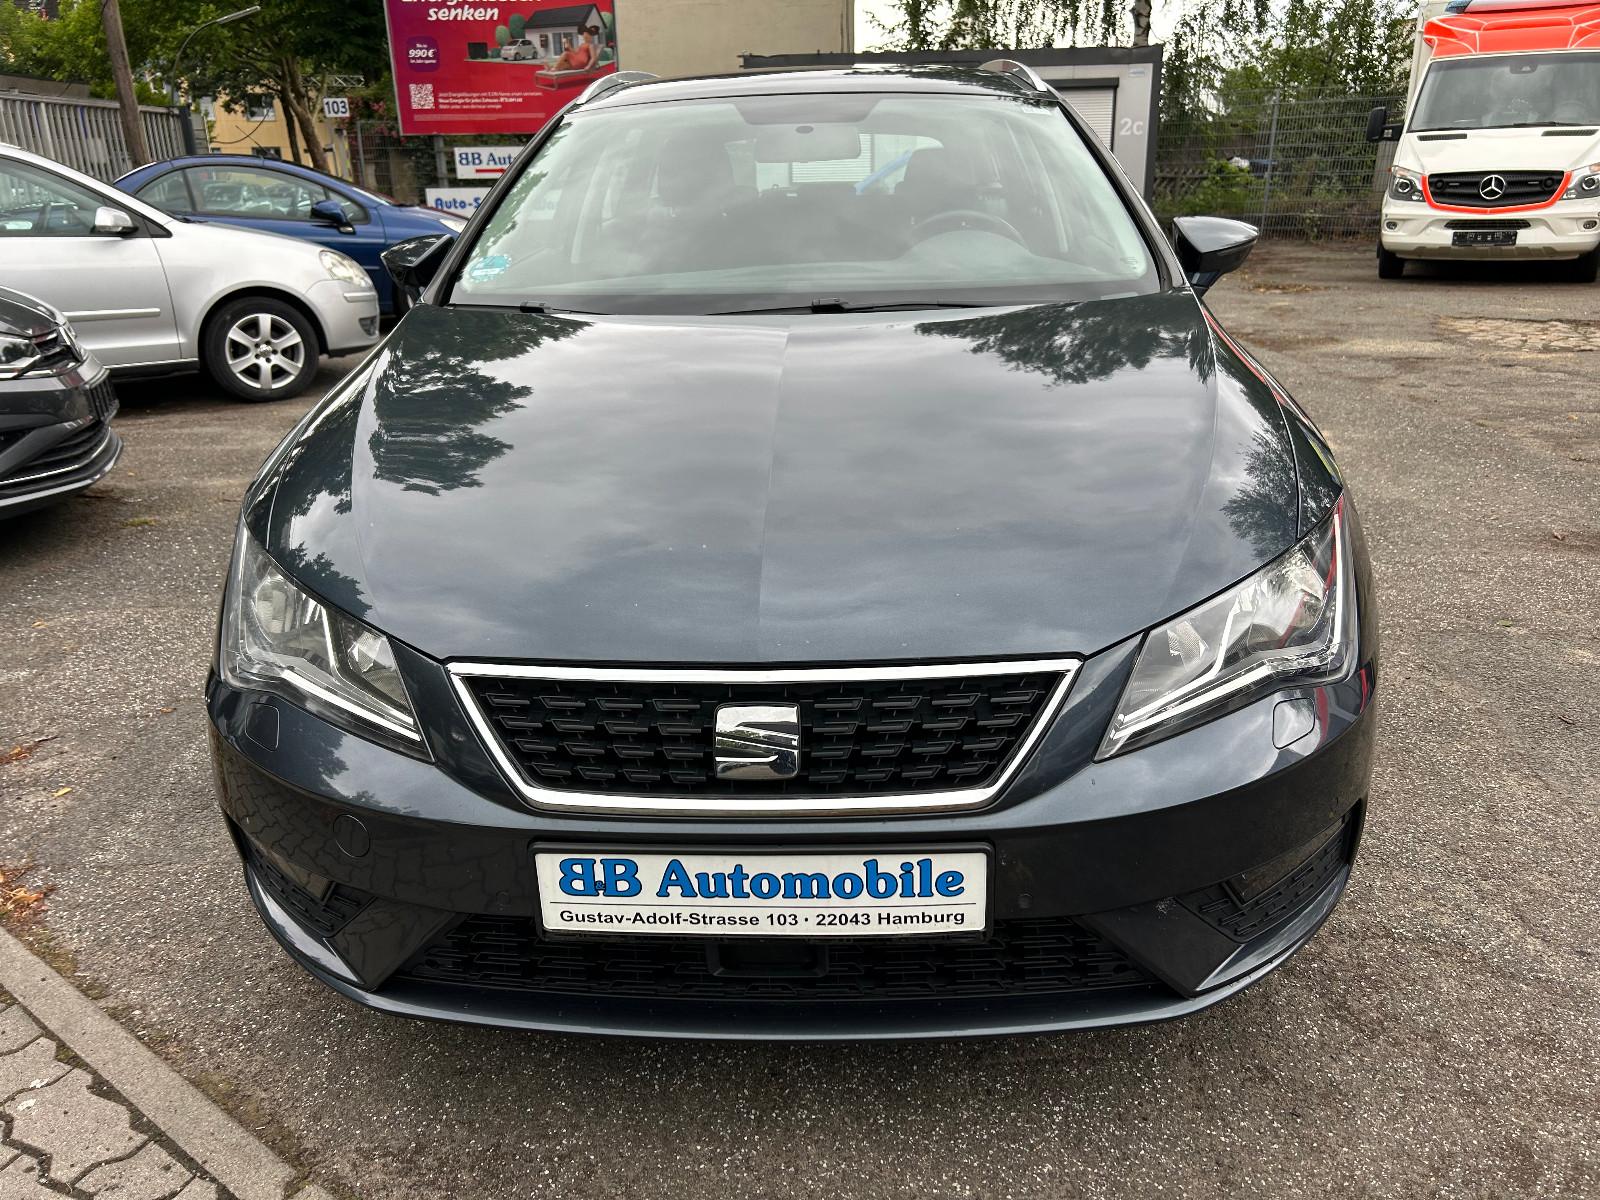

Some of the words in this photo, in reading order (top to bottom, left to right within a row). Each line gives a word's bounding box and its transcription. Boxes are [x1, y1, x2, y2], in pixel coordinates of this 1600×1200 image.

[428, 5, 499, 21] senken
[408, 49, 428, 58] 990
[325, 100, 347, 115] 103
[1120, 117, 1144, 135] 2c
[656, 858, 965, 899] Automobile
[559, 910, 760, 926] Gustav-Adolf-Strasse
[766, 913, 799, 926] 103
[815, 913, 871, 926] 22043
[877, 911, 966, 925] Hamburg
